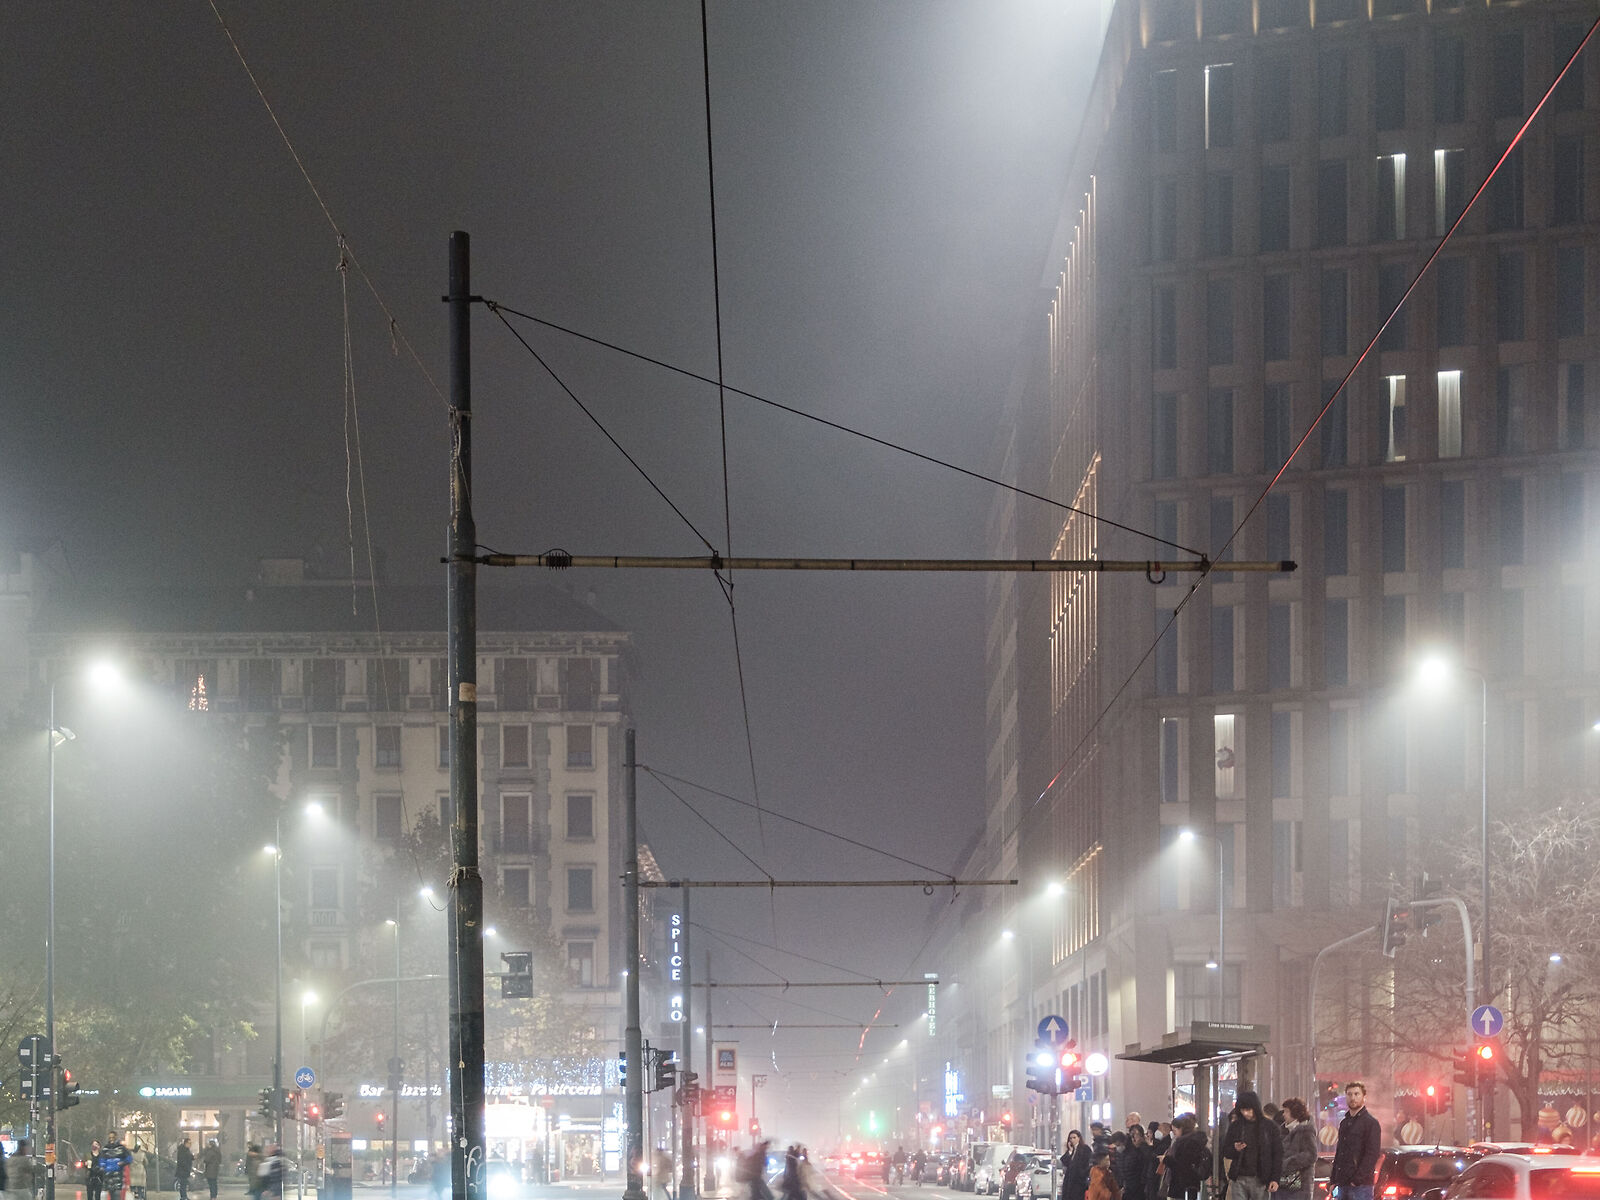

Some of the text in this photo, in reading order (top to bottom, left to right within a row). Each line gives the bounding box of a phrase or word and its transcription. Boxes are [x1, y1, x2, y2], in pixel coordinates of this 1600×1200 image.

[671, 914, 682, 981] SPICE
[155, 1087, 192, 1097] SAGAMI
[360, 1084, 385, 1097] Bar
